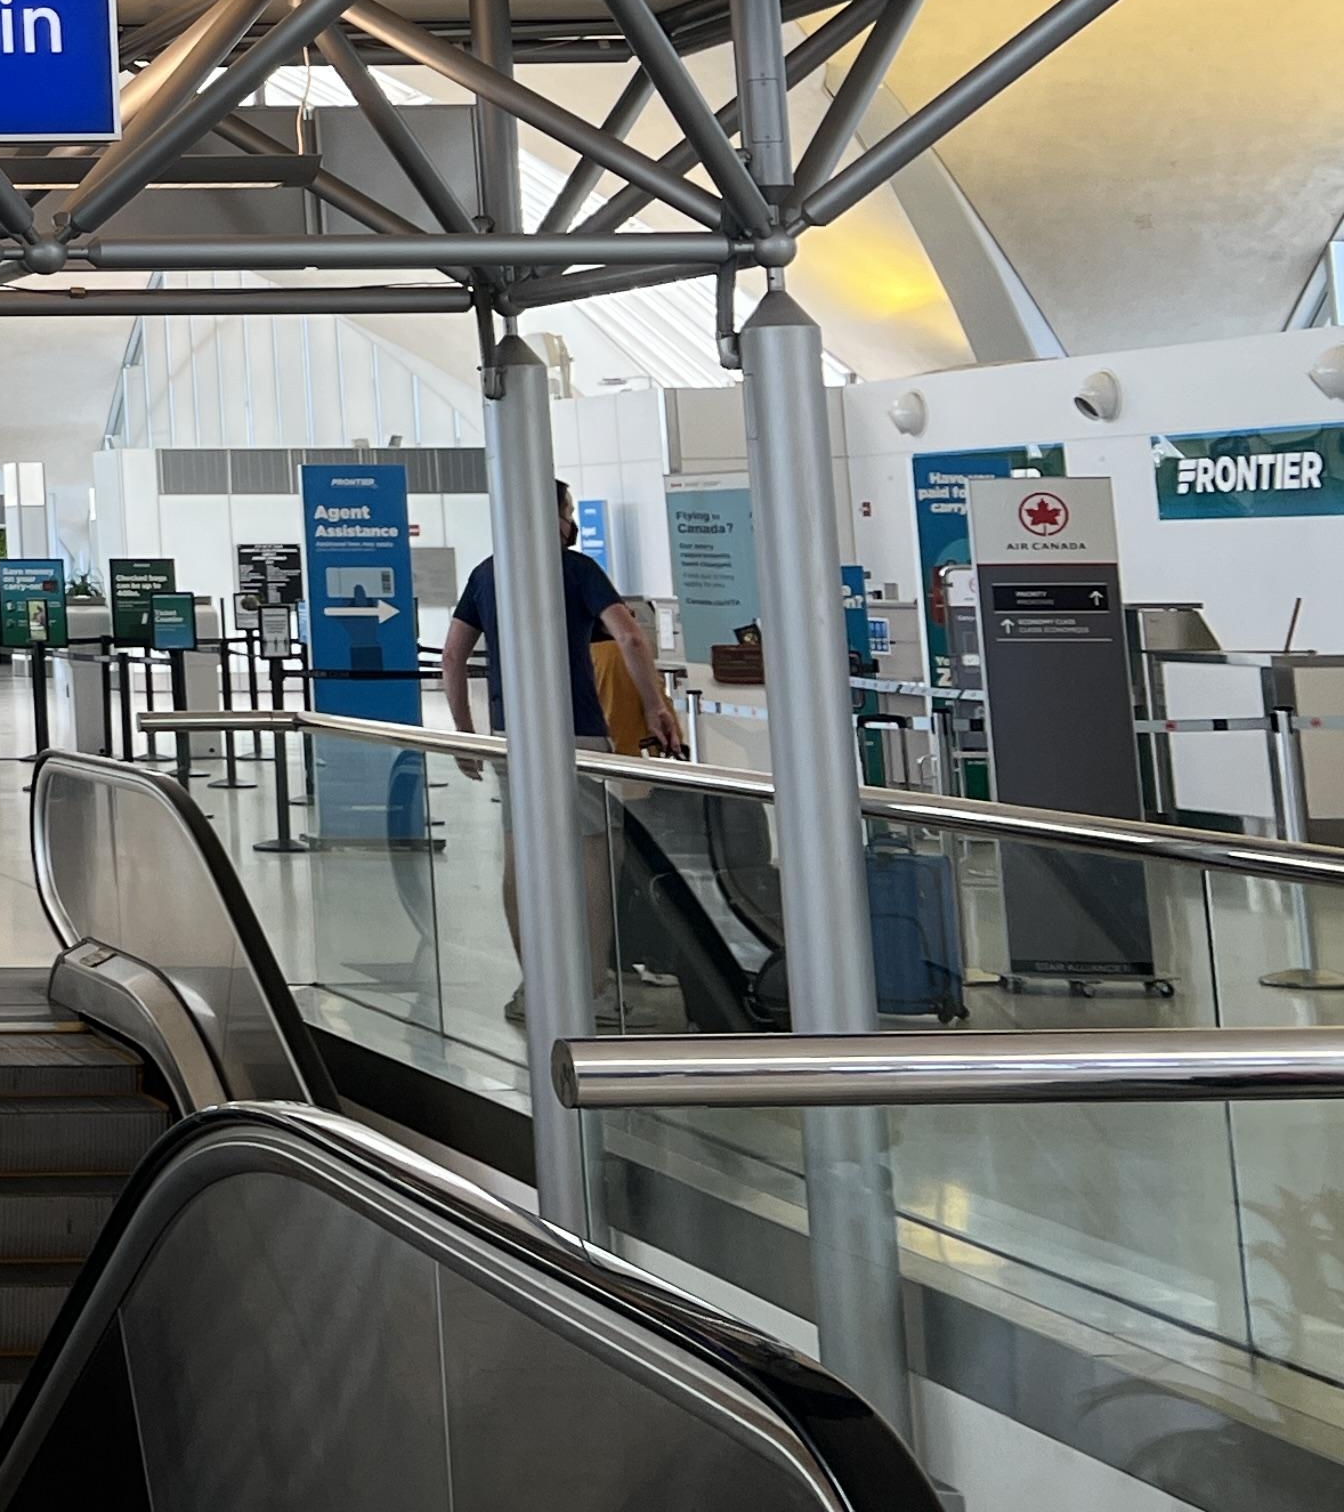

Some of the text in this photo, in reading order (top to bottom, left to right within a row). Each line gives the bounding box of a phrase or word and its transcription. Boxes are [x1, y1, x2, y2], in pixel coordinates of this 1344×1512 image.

[1177, 451, 1322, 495] FRONTIER
[314, 505, 371, 522] Agent
[676, 511, 710, 522] Flying
[315, 524, 399, 537] Assistance
[677, 523, 733, 534] Canada?
[1007, 541, 1087, 551] AIR CANADA
